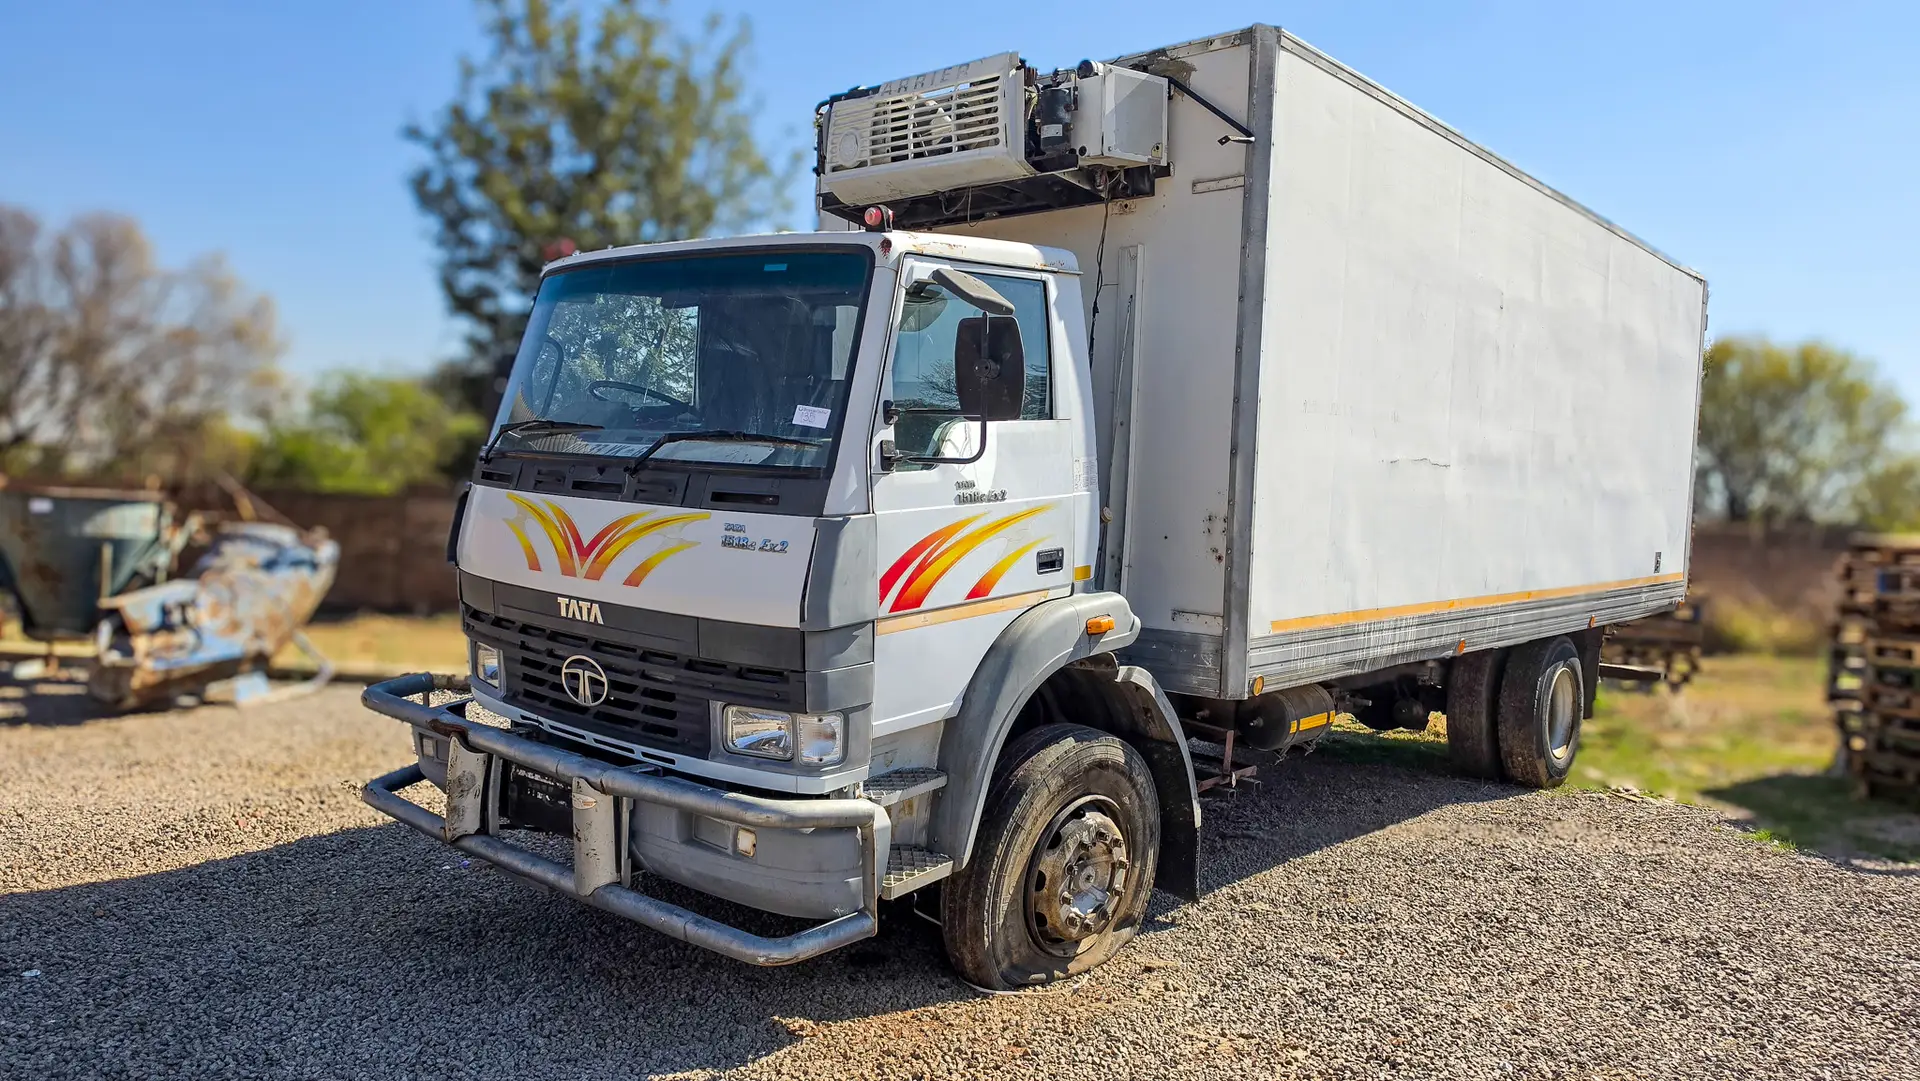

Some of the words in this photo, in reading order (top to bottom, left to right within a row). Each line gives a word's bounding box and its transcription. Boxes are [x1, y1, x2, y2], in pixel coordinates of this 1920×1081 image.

[880, 63, 970, 96] ARRIER
[758, 539, 789, 554] Ex2
[557, 597, 604, 625] TATA
